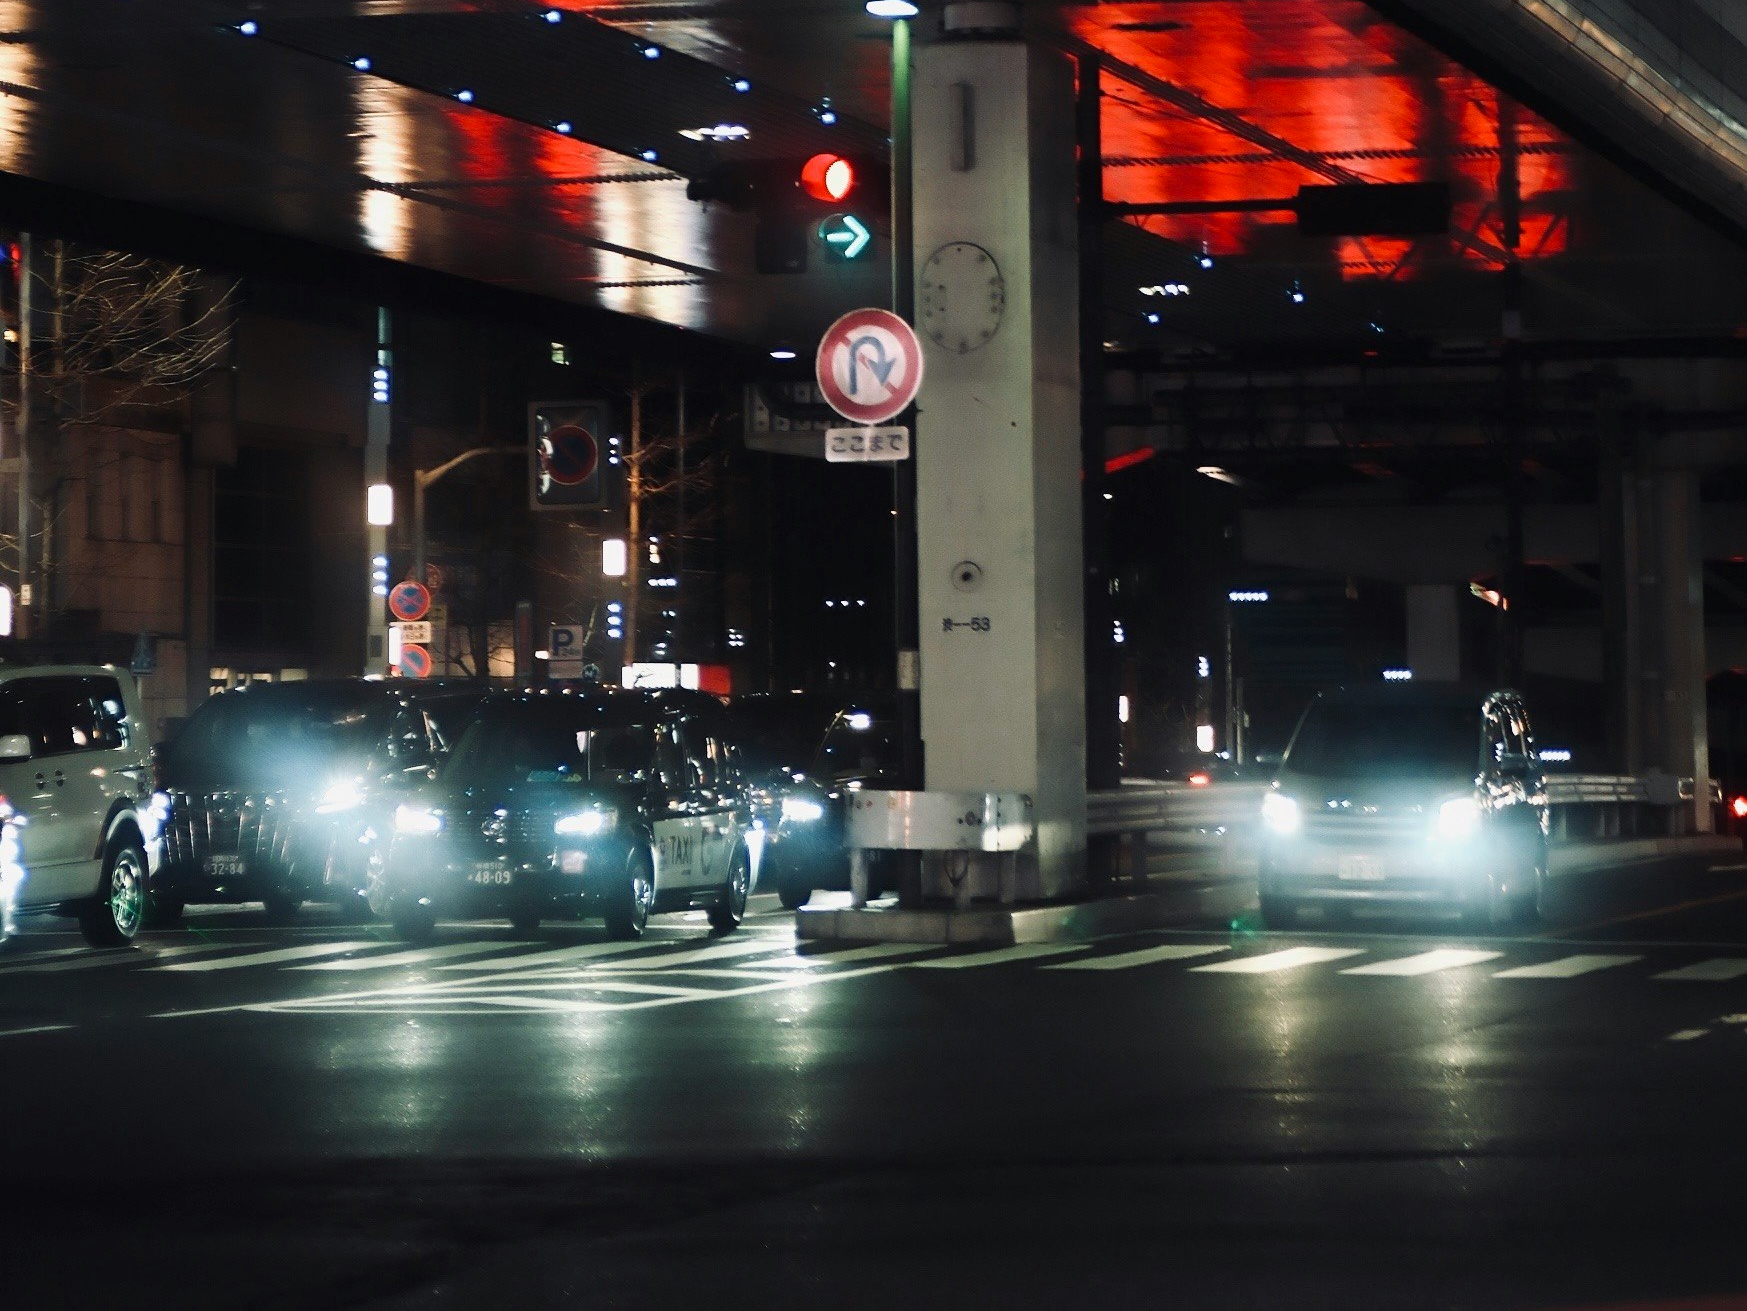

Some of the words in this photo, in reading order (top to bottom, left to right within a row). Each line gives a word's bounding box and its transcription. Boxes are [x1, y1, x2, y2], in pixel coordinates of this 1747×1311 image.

[832, 434, 903, 453] ここまで
[552, 628, 574, 656] P
[669, 835, 693, 864] TAXI
[211, 862, 243, 875] 32-84
[475, 871, 510, 884] 48-09
